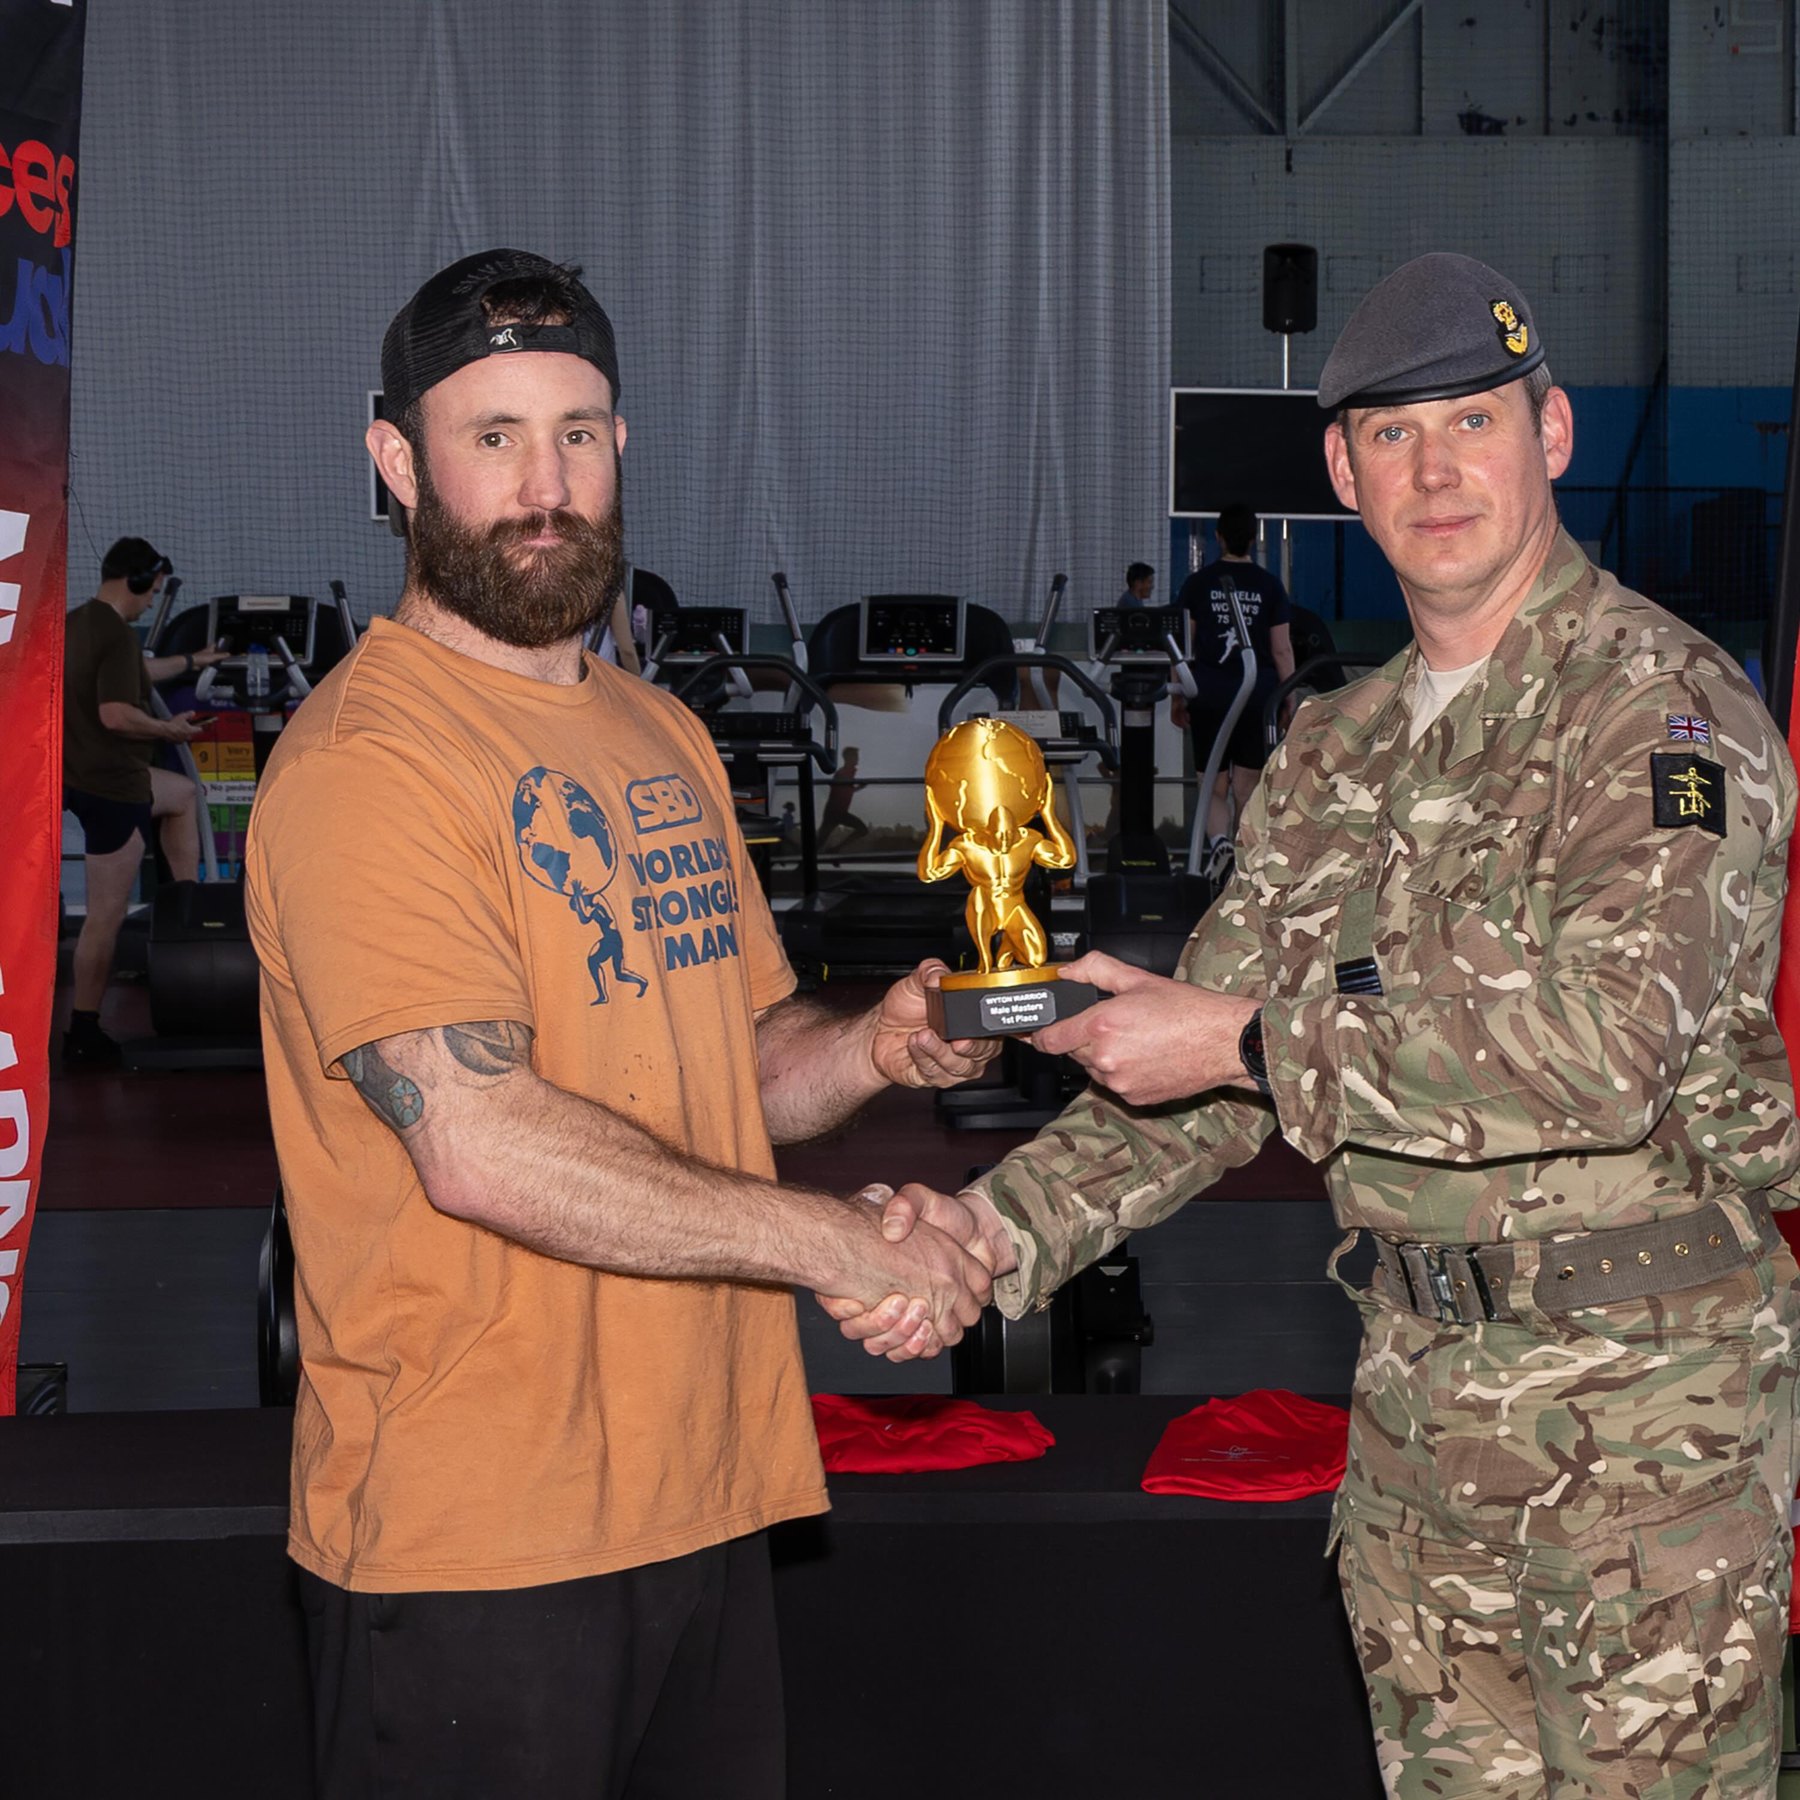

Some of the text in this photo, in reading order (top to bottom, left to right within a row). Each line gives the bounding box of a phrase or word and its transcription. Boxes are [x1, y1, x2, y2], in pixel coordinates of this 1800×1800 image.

[1210, 590, 1262, 603] DHELIA
[1211, 602, 1260, 615] WON'S
[628, 776, 701, 831] SBD
[664, 922, 739, 971] MAN
[985, 992, 1048, 1005] WYTON WARRIOR
[990, 1003, 1044, 1015] Male Masters
[1001, 1014, 1039, 1024] 1st Place
